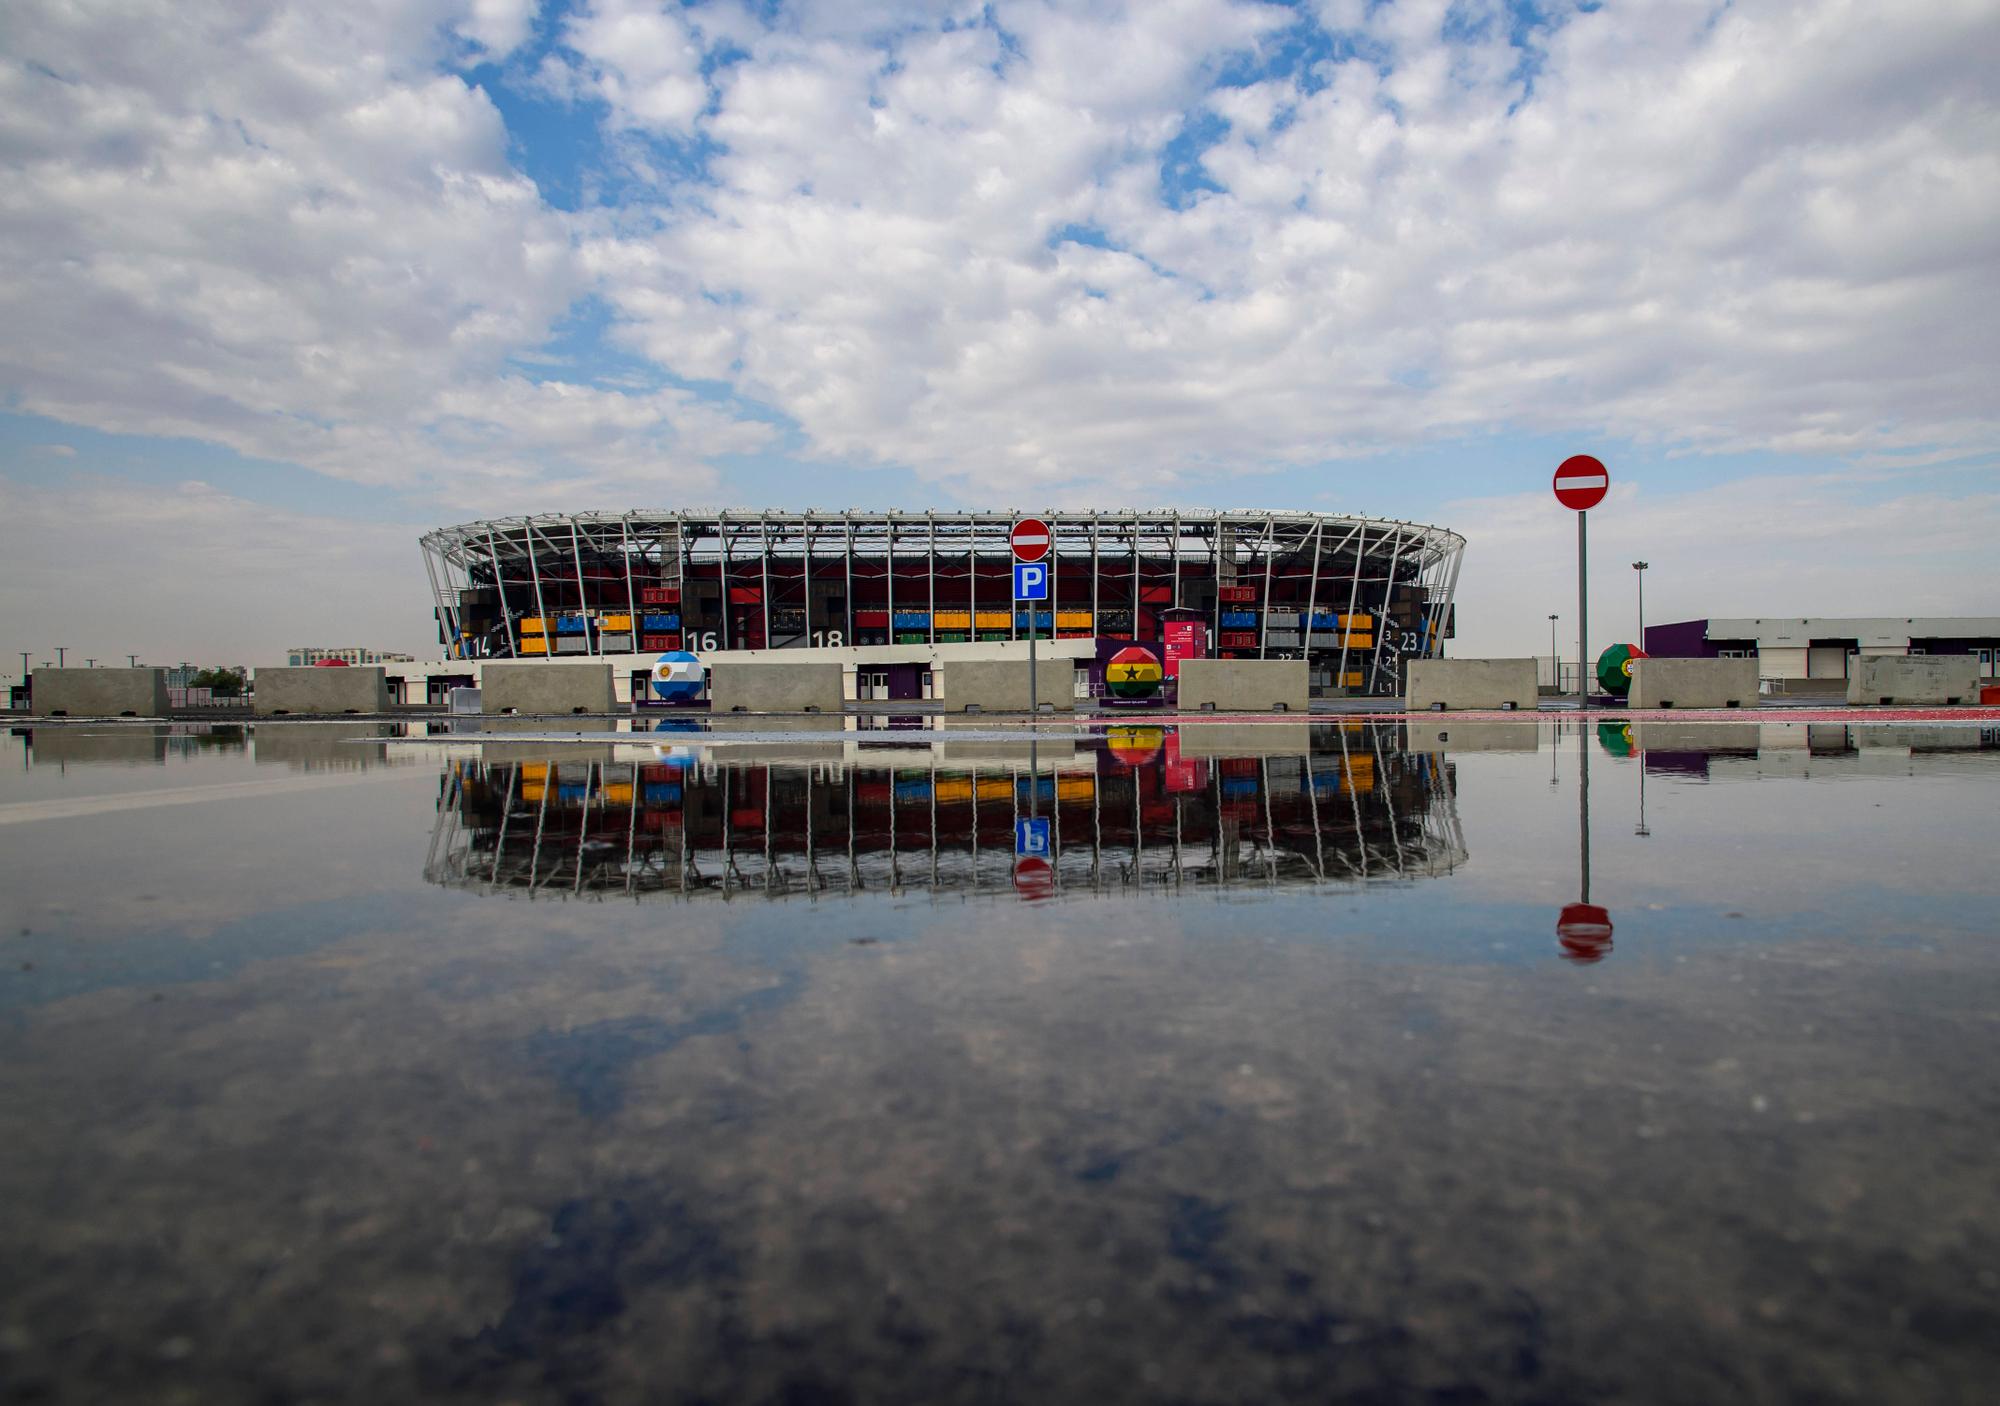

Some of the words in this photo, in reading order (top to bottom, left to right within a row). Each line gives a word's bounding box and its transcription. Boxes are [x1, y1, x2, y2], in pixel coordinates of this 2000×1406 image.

[1022, 567, 1042, 597] P
[473, 636, 490, 657] 14
[687, 631, 717, 654] 16
[812, 629, 843, 649] 18
[1401, 632, 1418, 651] 23
